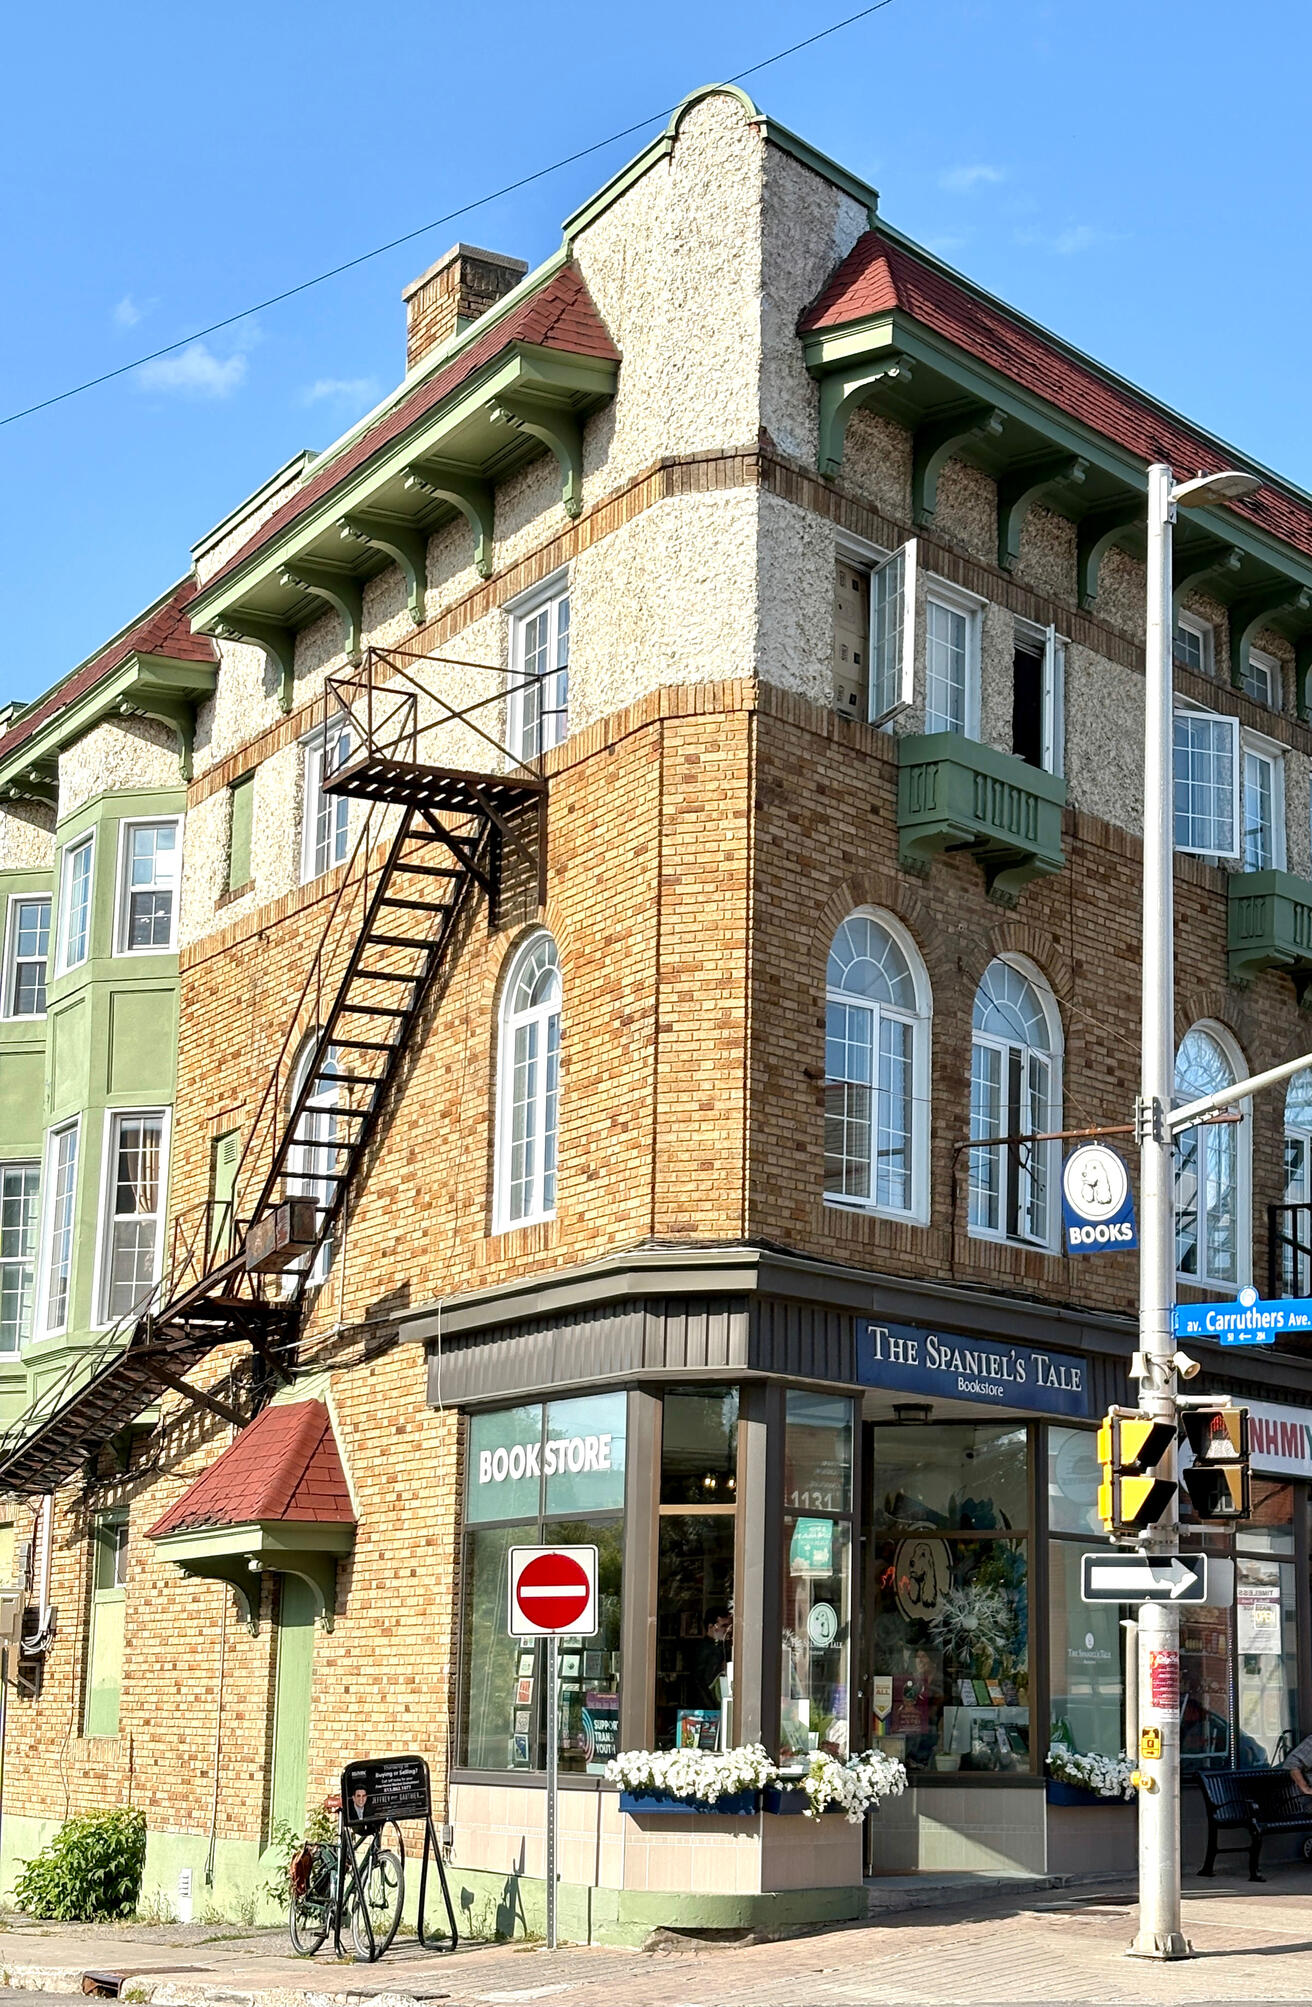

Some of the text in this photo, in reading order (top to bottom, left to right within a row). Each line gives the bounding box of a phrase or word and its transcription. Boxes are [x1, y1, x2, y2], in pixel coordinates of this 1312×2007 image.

[1069, 1223, 1133, 1245] BOOKS
[1187, 1307, 1311, 1332] av. Carruthers Ave.
[868, 1326, 1082, 1391] THE SPANIEL'S TALE
[958, 1377, 1004, 1397] Bookstore
[791, 1491, 833, 1509] 1131
[595, 1732, 614, 1742] TRANS
[596, 1744, 616, 1754] YOUTH
[399, 1768, 418, 1776] Selling?
